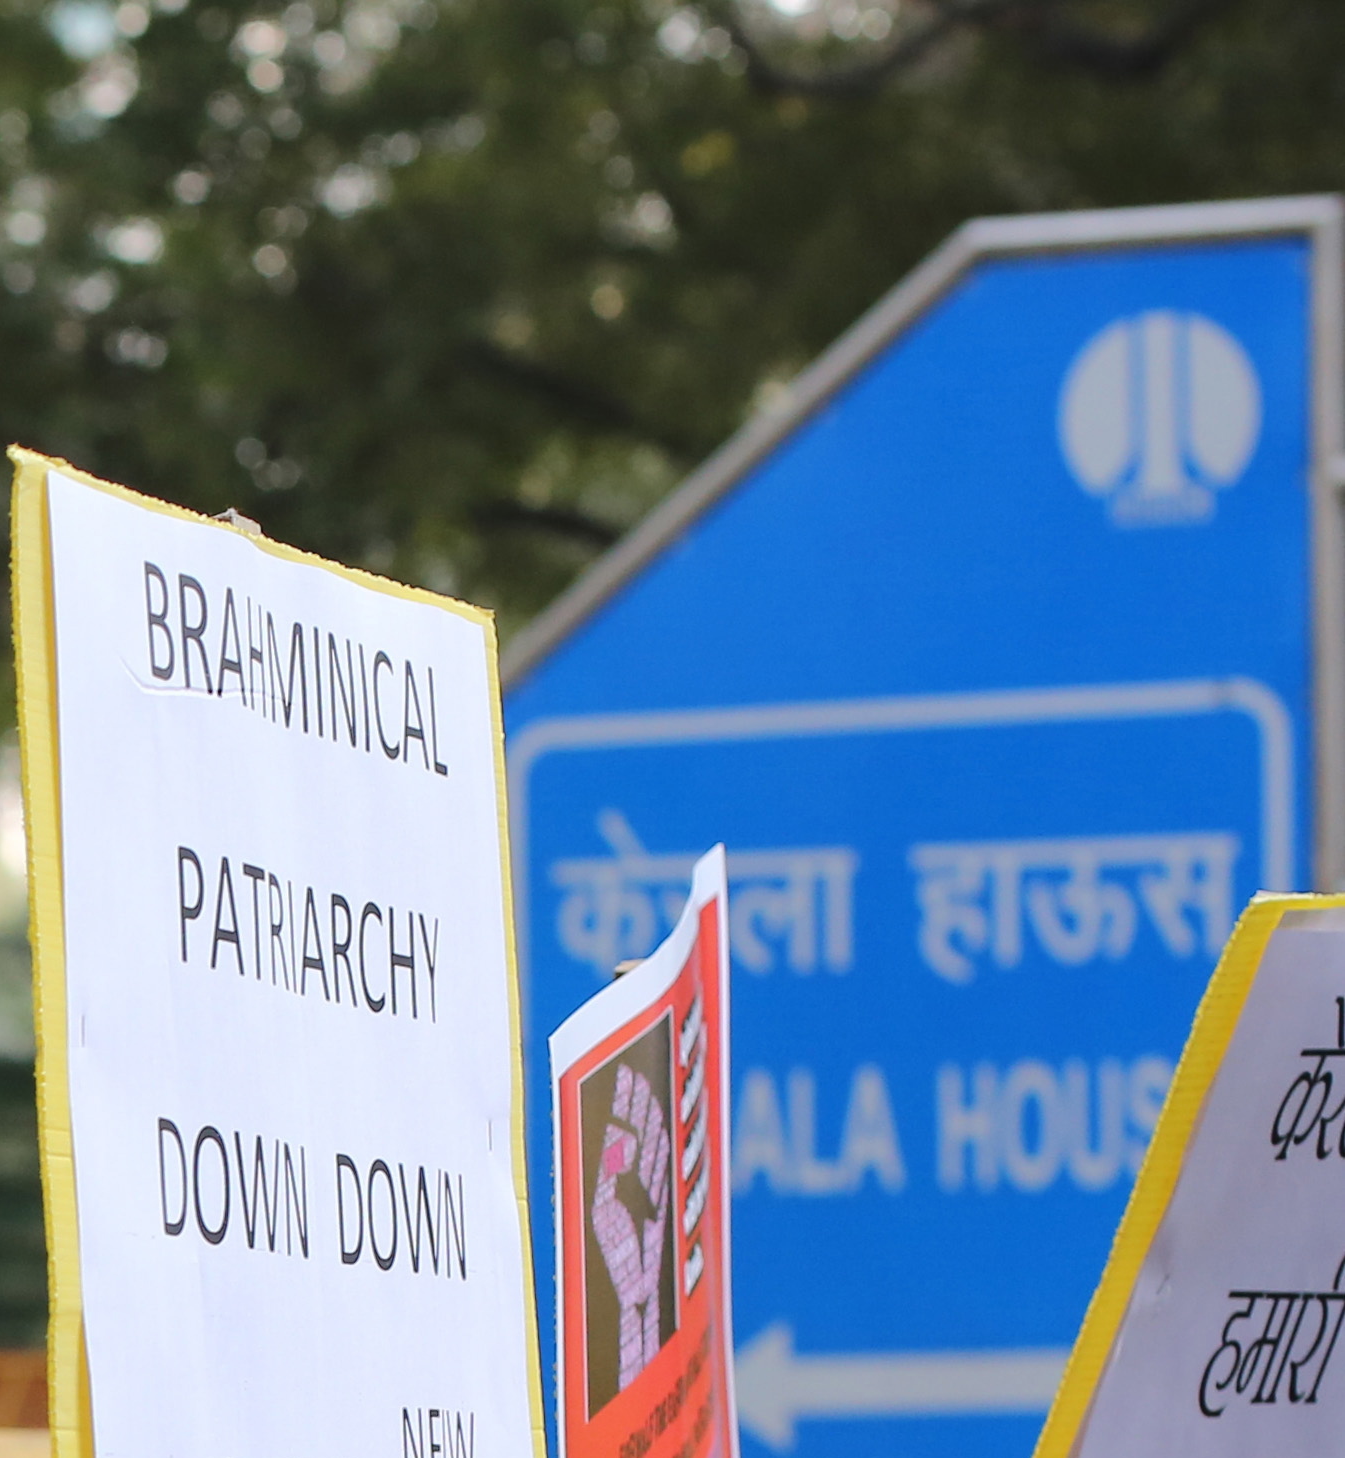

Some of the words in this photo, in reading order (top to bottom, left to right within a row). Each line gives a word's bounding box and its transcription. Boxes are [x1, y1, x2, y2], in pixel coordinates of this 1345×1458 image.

[144, 560, 448, 777] BRAHMINICAL
[177, 845, 439, 1023] PATRIARCHY
[550, 807, 856, 978] केला
[907, 830, 1242, 986] हाऊस
[158, 1116, 309, 1260] DOWN
[335, 1153, 467, 1282] DOWN
[732, 1062, 910, 1196] ALA
[931, 1055, 1186, 1198] HOUS
